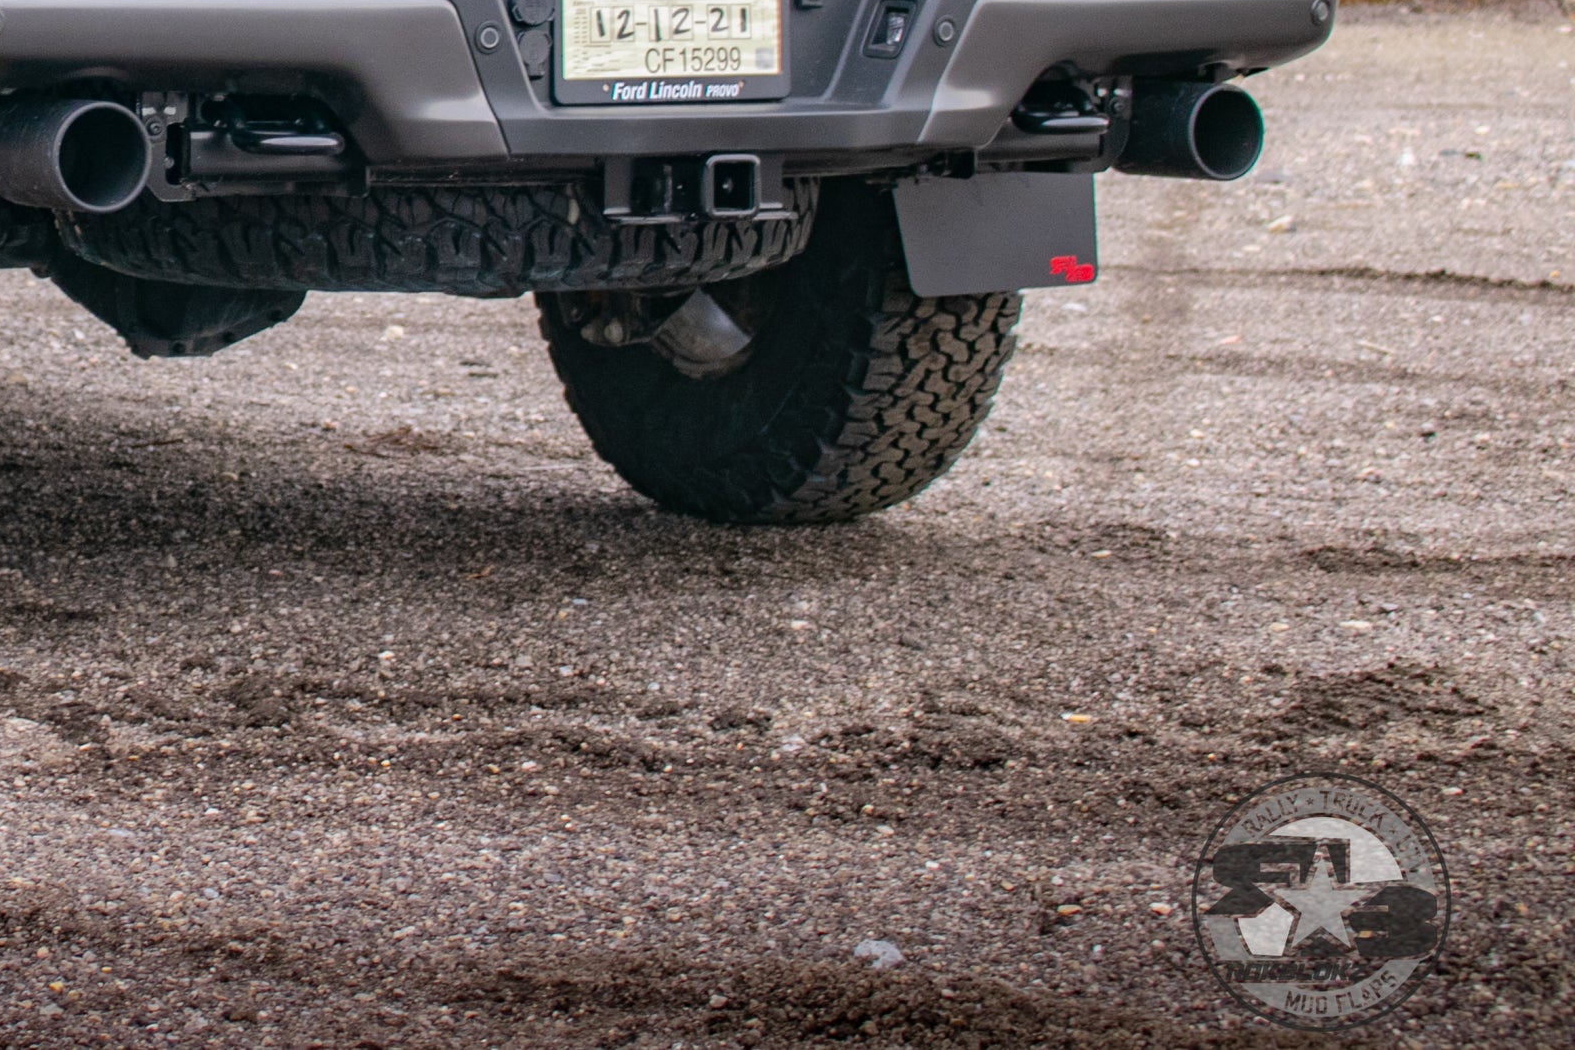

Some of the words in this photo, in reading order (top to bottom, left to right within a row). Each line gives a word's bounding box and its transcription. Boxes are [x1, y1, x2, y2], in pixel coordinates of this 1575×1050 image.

[644, 46, 742, 74] CF15299
[612, 82, 648, 101] Ford
[649, 80, 703, 100] Lincoln
[705, 84, 740, 98] PROVO
